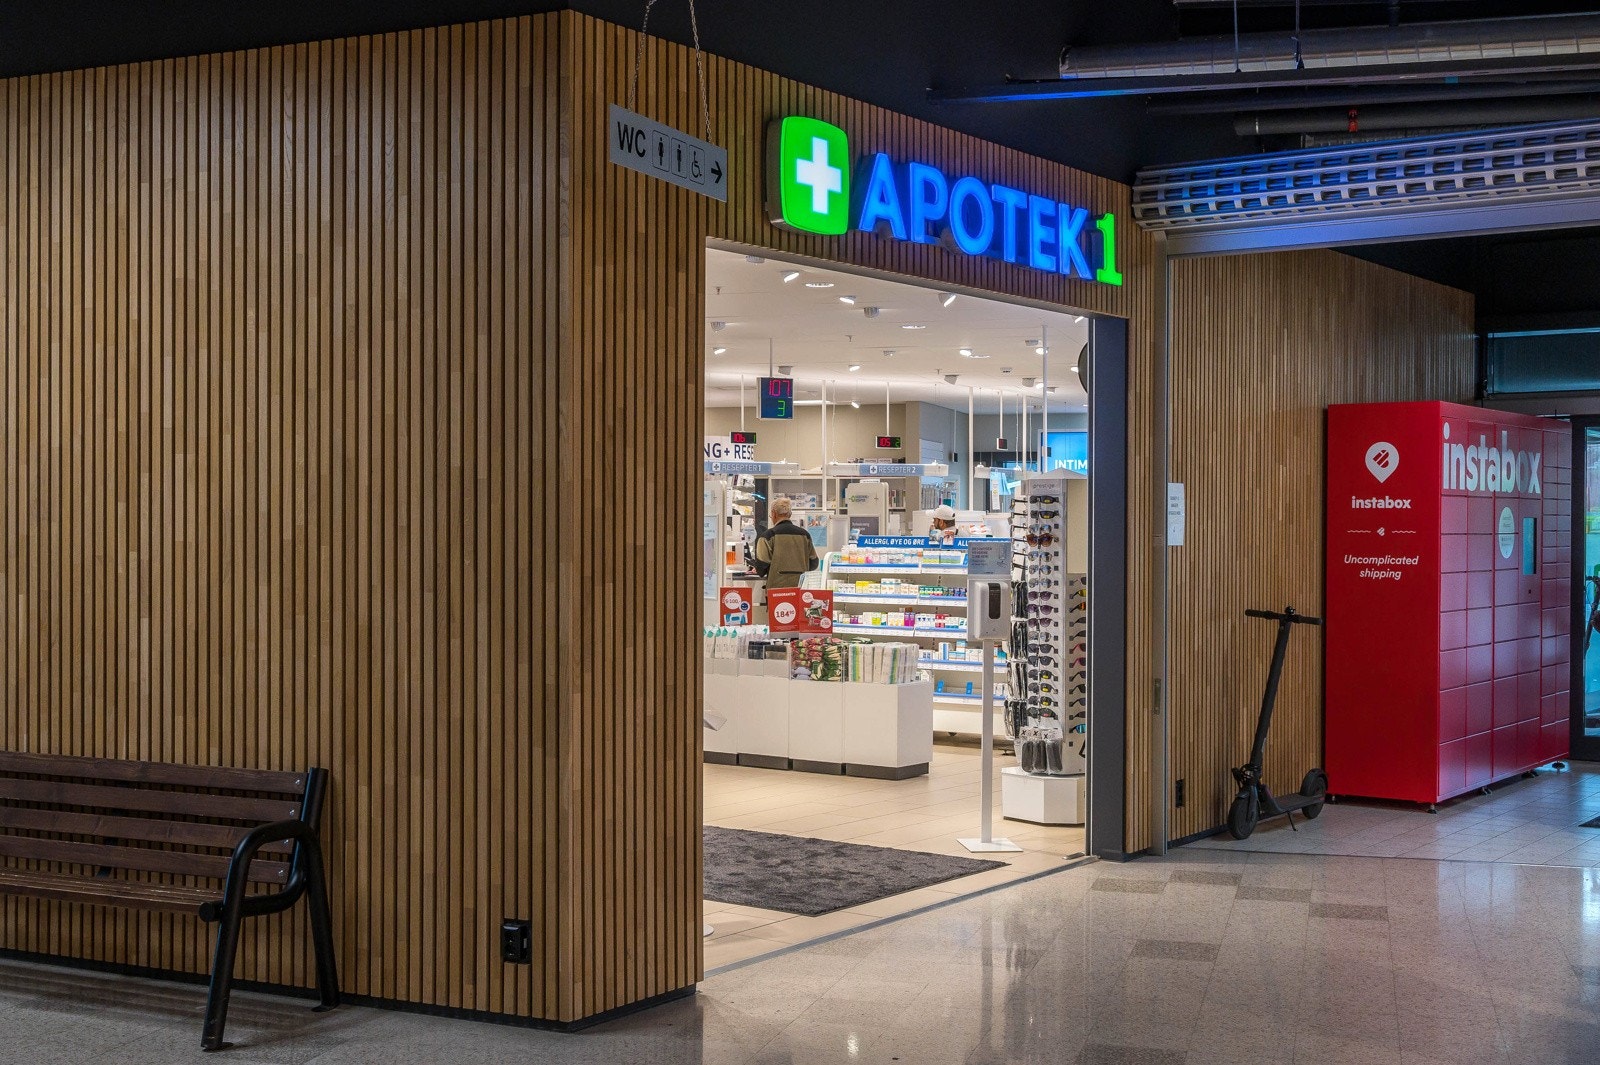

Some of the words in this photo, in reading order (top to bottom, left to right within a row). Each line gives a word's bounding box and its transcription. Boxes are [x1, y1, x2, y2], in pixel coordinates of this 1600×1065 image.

[617, 121, 646, 158] WC
[858, 152, 1093, 280] APOTEK
[1096, 212, 1123, 286] 1
[768, 379, 791, 397] 107
[777, 400, 786, 417] 3
[1054, 459, 1087, 470] INTIM
[1443, 421, 1541, 494] instabox
[878, 465, 911, 473] RESEPTER
[1351, 495, 1412, 509] instabox
[1343, 554, 1419, 566] Uncomplicated
[1359, 569, 1402, 580] shipping
